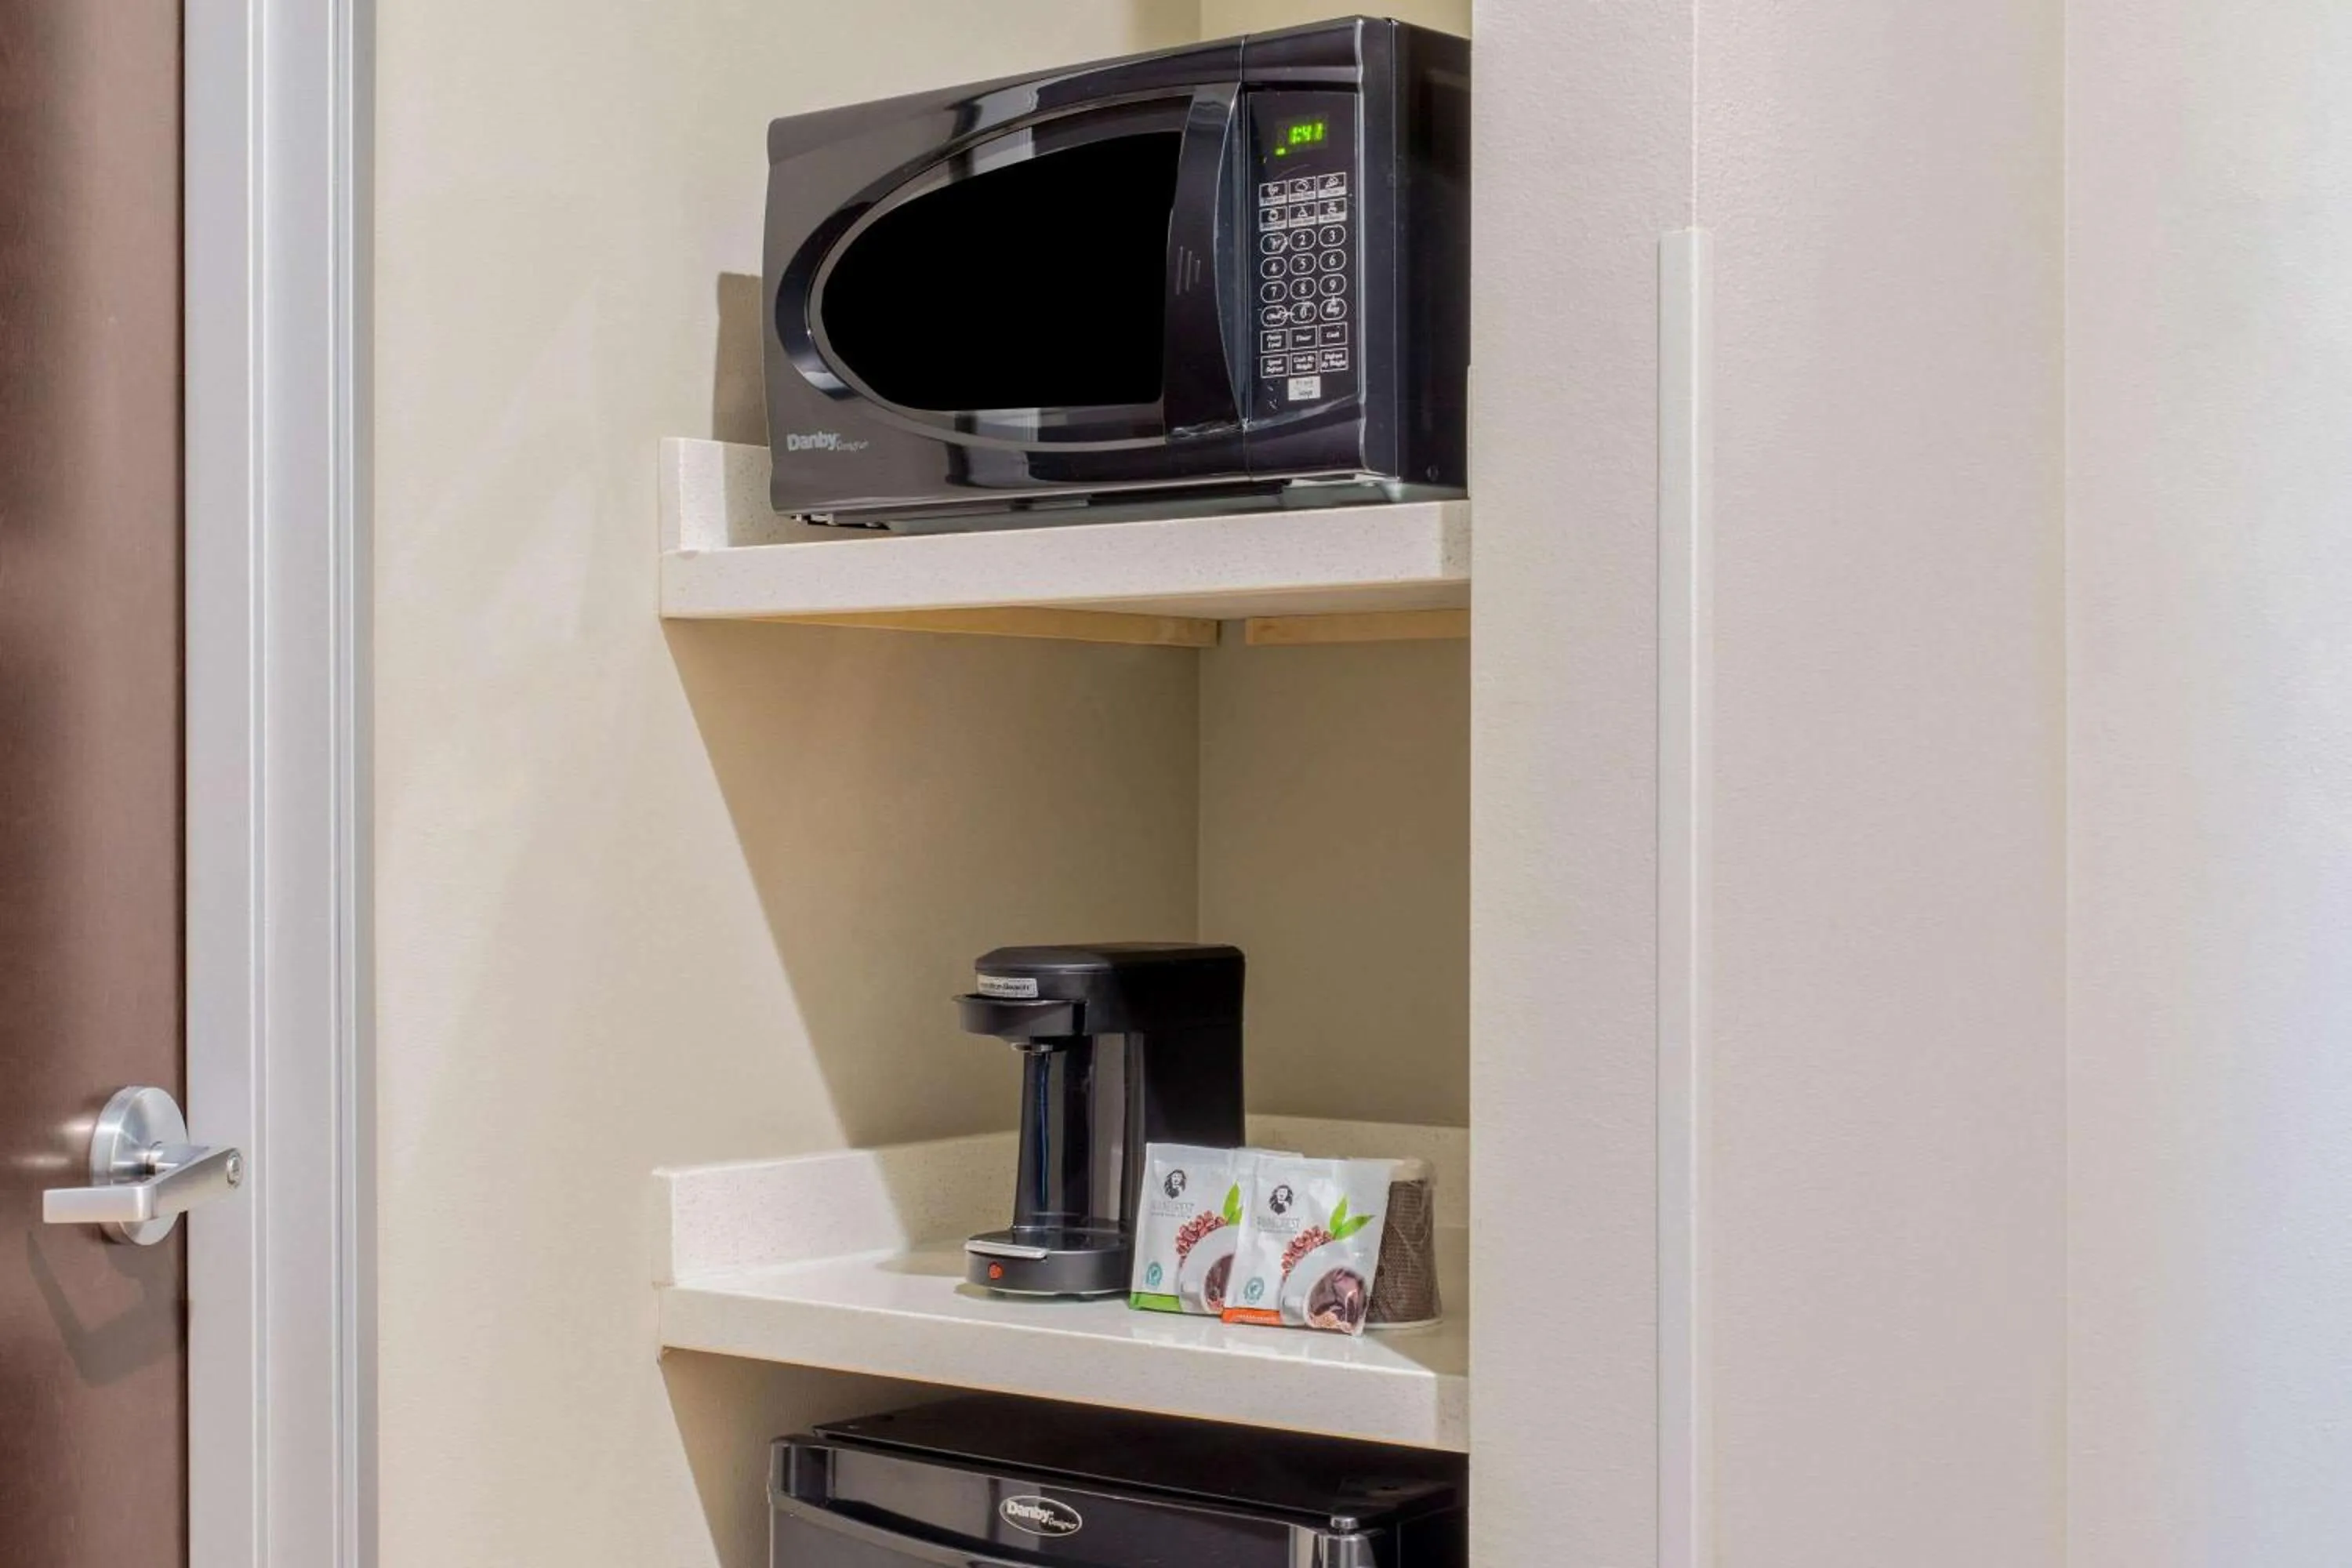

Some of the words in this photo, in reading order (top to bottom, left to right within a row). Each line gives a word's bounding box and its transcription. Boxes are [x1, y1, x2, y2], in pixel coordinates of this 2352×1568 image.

[1298, 234, 1305, 245] 2
[1329, 230, 1335, 242] 3
[1298, 257, 1305, 270] 5
[1329, 254, 1336, 266] 6
[1270, 263, 1278, 273] 4
[1299, 282, 1306, 294] 8
[1329, 279, 1336, 291] 9
[1270, 286, 1276, 297] 7
[786, 430, 838, 452] Danby
[1006, 1499, 1052, 1523] Danby
